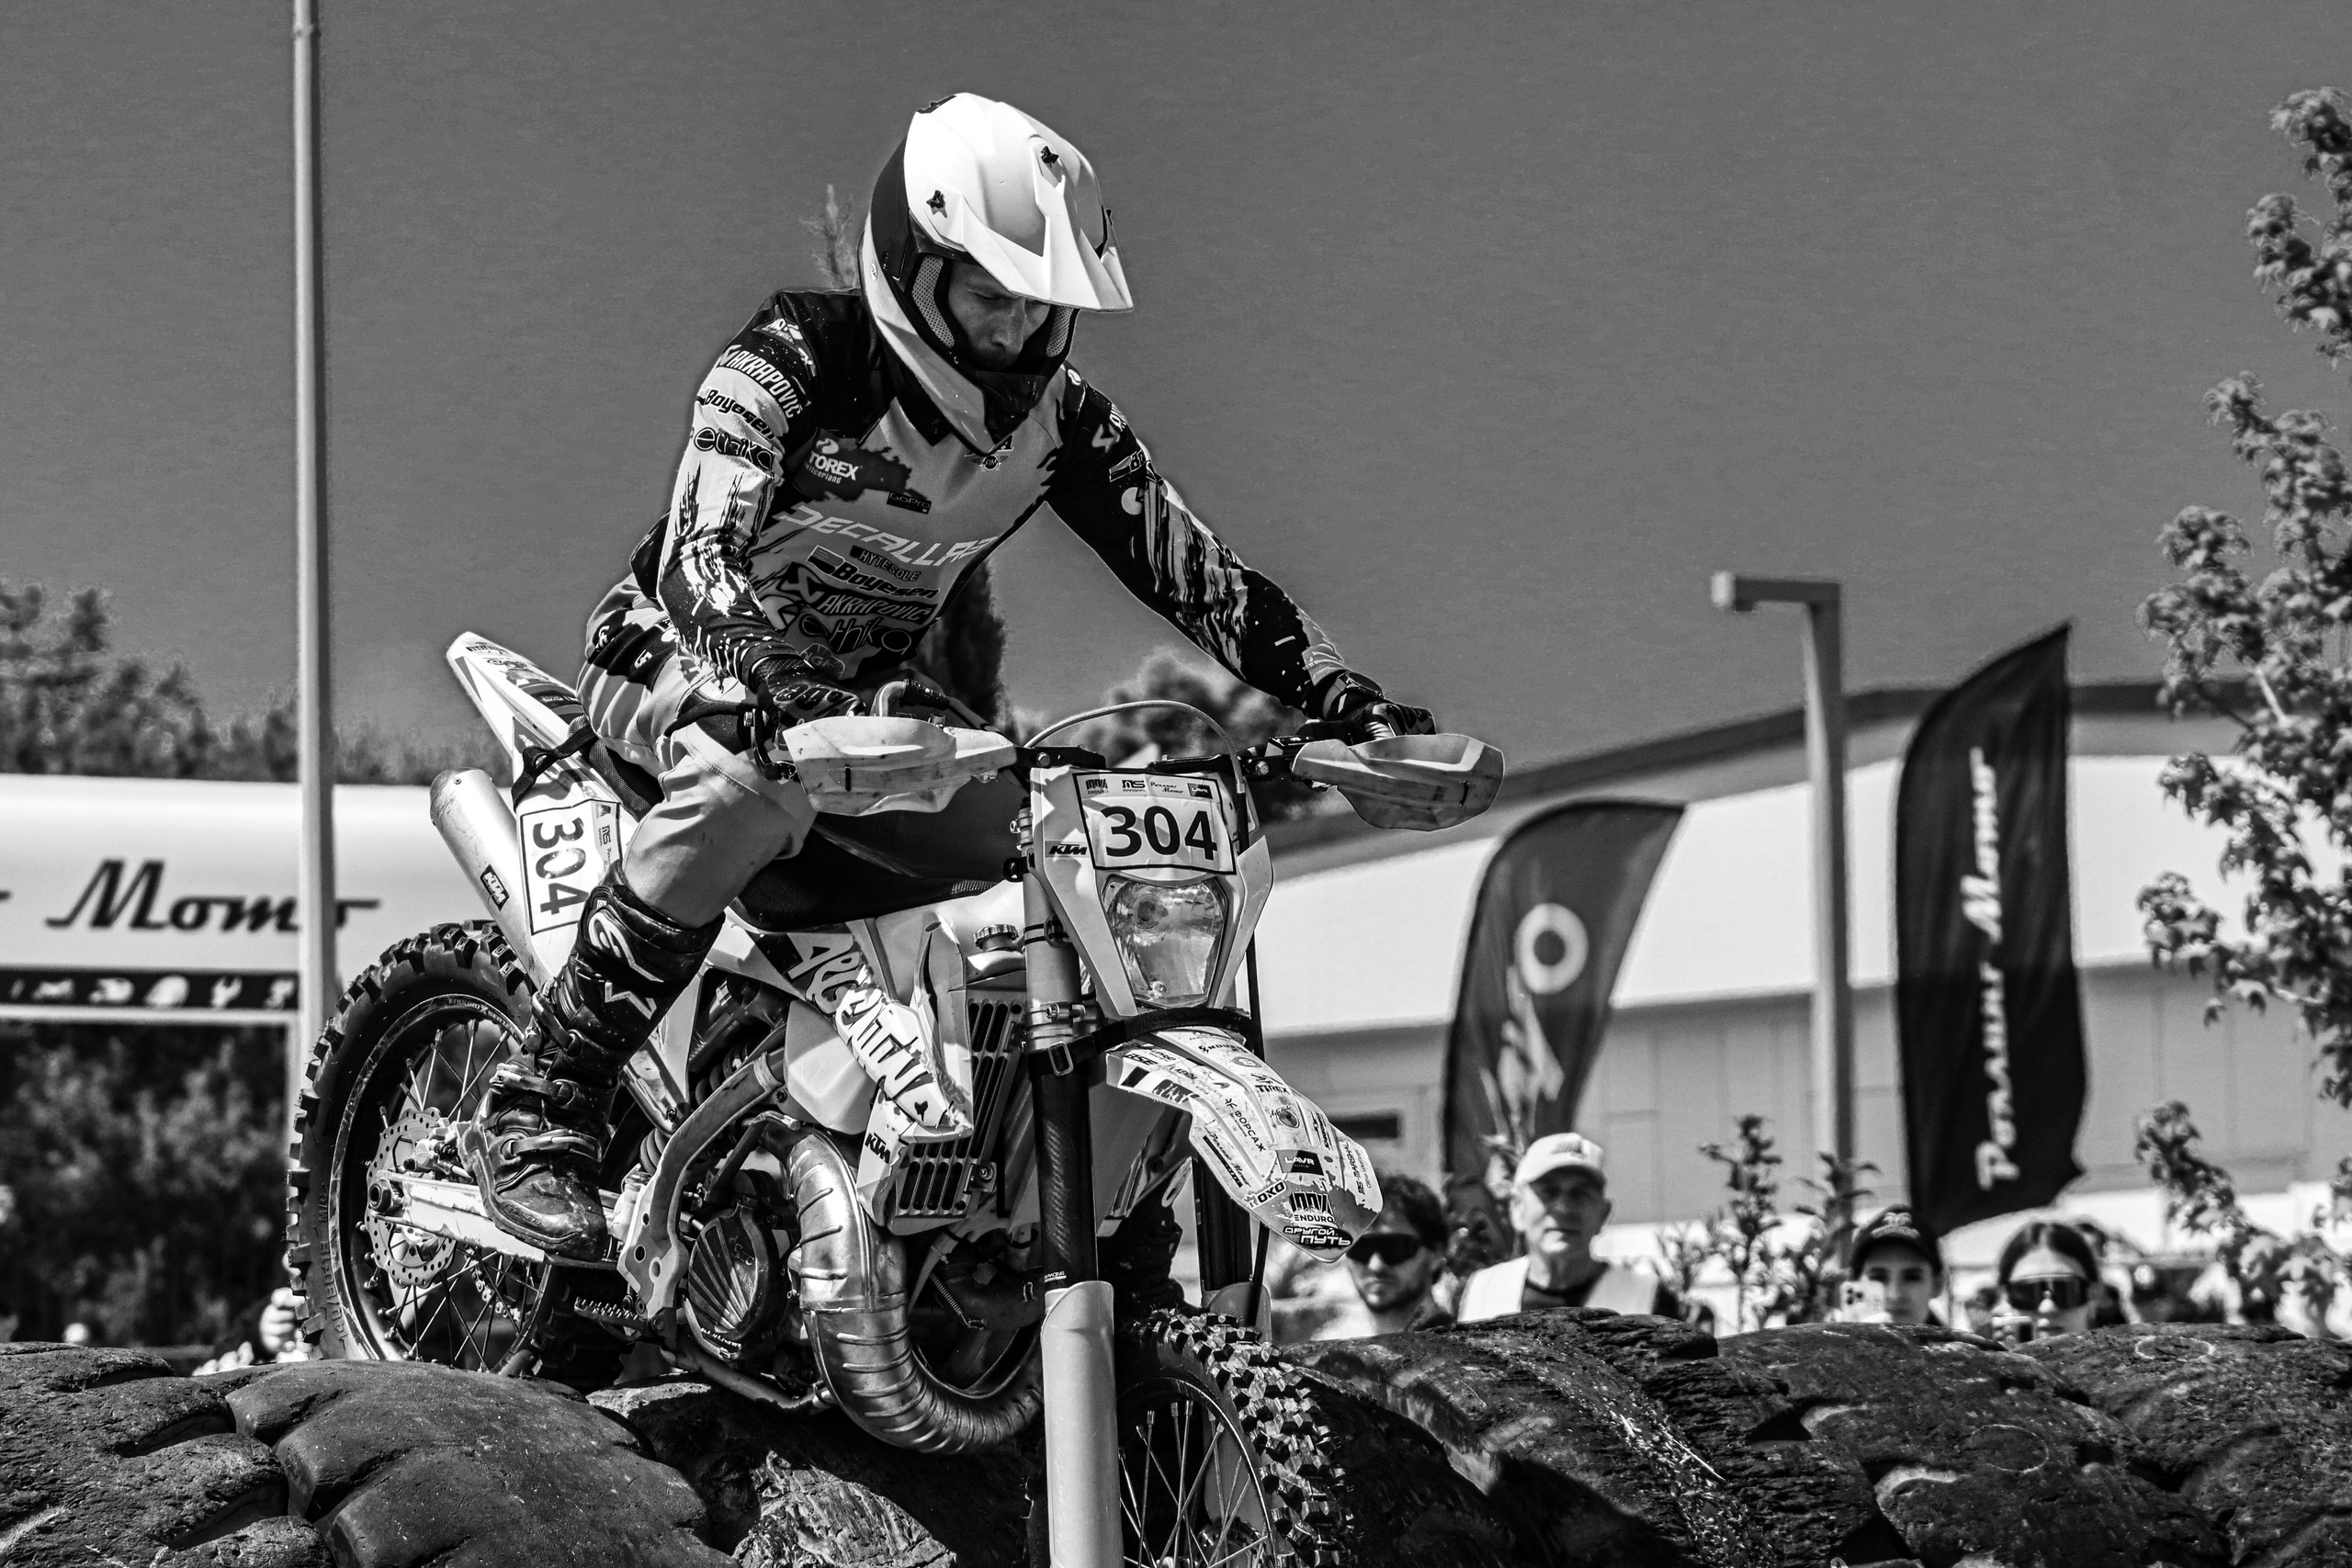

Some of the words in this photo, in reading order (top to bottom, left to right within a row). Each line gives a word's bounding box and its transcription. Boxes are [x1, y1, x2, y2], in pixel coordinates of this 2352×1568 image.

[705, 389, 776, 441] Boyesen
[809, 451, 860, 481] TOREX
[888, 491, 932, 509] GoPro
[831, 562, 941, 600] Boyesen
[858, 550, 922, 582] HYTESOLE
[1100, 805, 1218, 861] 304
[1047, 844, 1088, 855] KTM
[532, 817, 590, 915] 304
[483, 871, 507, 902] KTM
[1234, 1110, 1267, 1152] ФОРСАЖ
[865, 1133, 891, 1165] KTM
[1284, 1156, 1315, 1166] LAVR
[1248, 1180, 1285, 1208] ROKO
[1284, 1227, 1335, 1236] ДРУГОЙ
[1294, 1214, 1334, 1224] ENDURO
[1300, 1235, 1351, 1247] ПУТЬ
